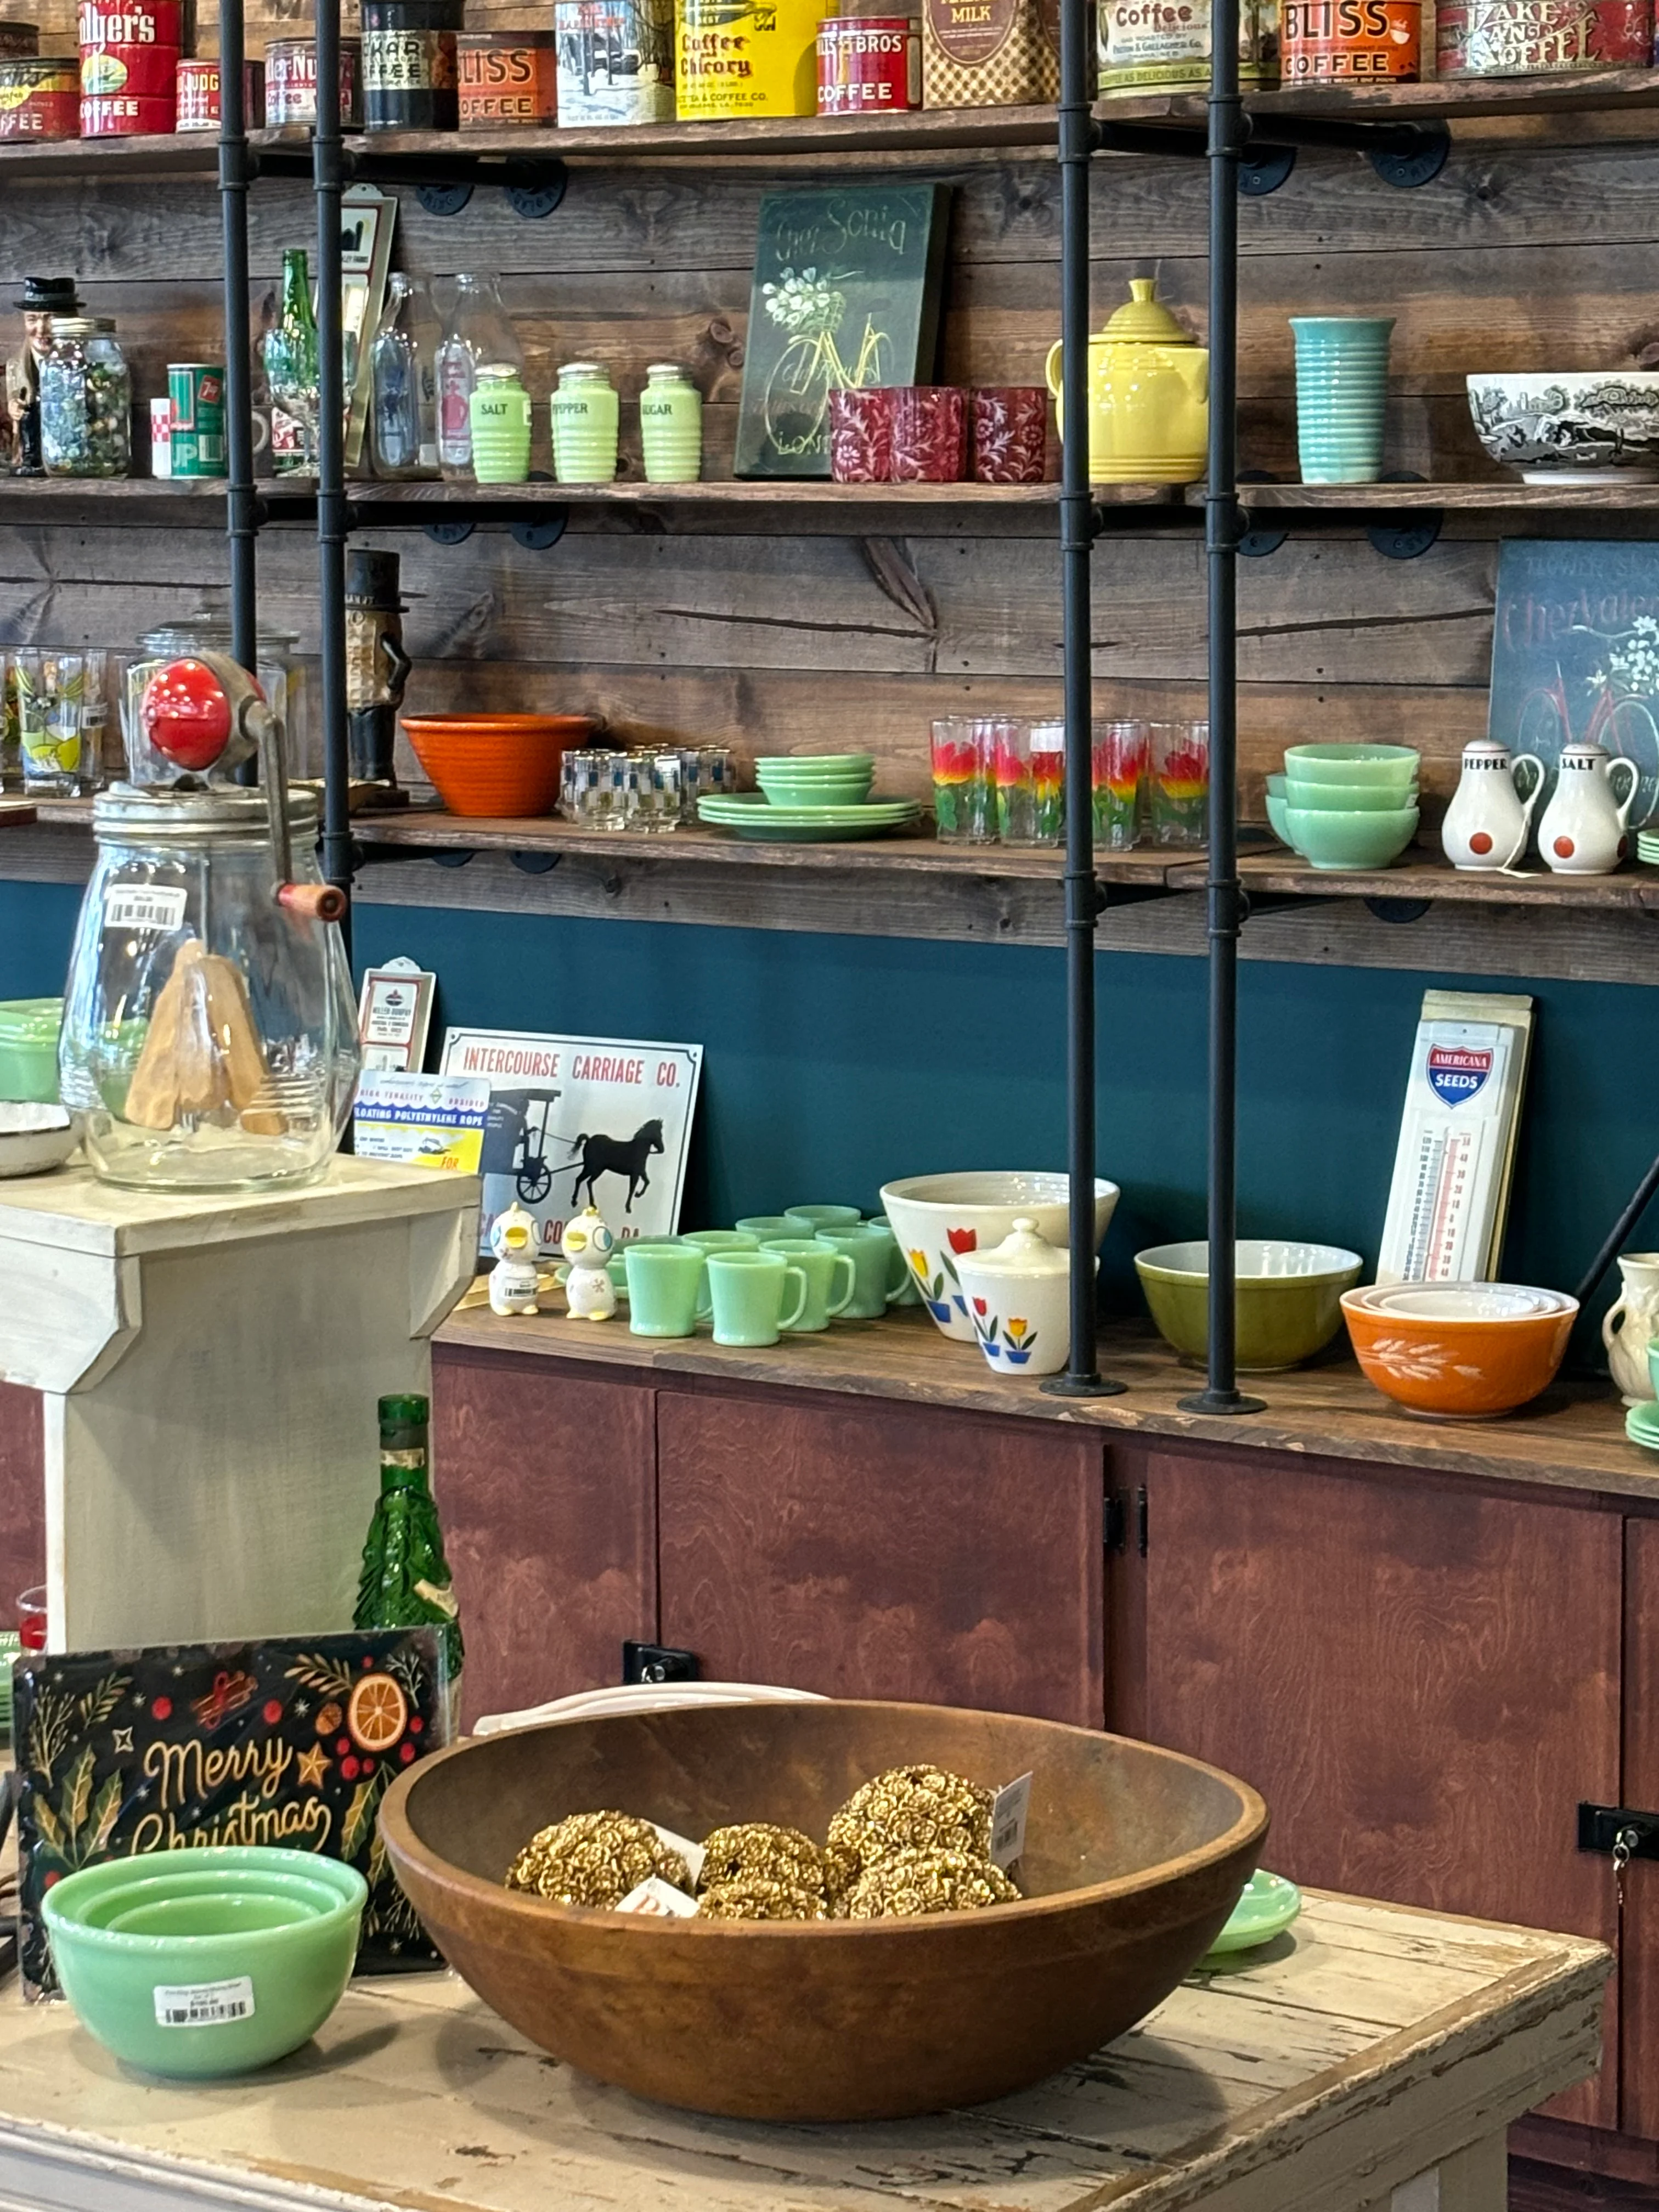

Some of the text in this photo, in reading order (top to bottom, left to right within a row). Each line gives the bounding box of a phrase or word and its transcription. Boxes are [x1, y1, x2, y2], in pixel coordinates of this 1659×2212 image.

[951, 5, 992, 24] MILK
[1116, 3, 1193, 27] Coffee
[1285, 0, 1388, 40] BLISS
[80, 2, 155, 54] olger's
[681, 33, 751, 53] Coffee
[856, 35, 902, 53] BROS
[463, 49, 533, 83] LISS
[681, 57, 753, 80] Chicory
[1285, 53, 1388, 75] COFFEE
[184, 72, 219, 92] JUDG
[710, 93, 747, 101] COFFEE
[816, 83, 893, 103] COFFEE
[80, 99, 138, 119] COFFEE
[461, 98, 533, 115] OFFEE
[0, 112, 43, 130] FFEE
[481, 403, 508, 415] SALT
[1464, 758, 1508, 770] PEPPER
[1562, 758, 1596, 771] SALT
[463, 1047, 680, 1088] INTERCOURSE CARRIAGE CO.
[1432, 1053, 1487, 1068] AMERICANA
[1435, 1073, 1478, 1089] SEEDS
[354, 1107, 392, 1120] LOATING
[459, 1116, 484, 1126] ROPE
[441, 1156, 459, 1170] FOR
[143, 1736, 292, 1809] Merry
[131, 1791, 332, 1854] Christmas
